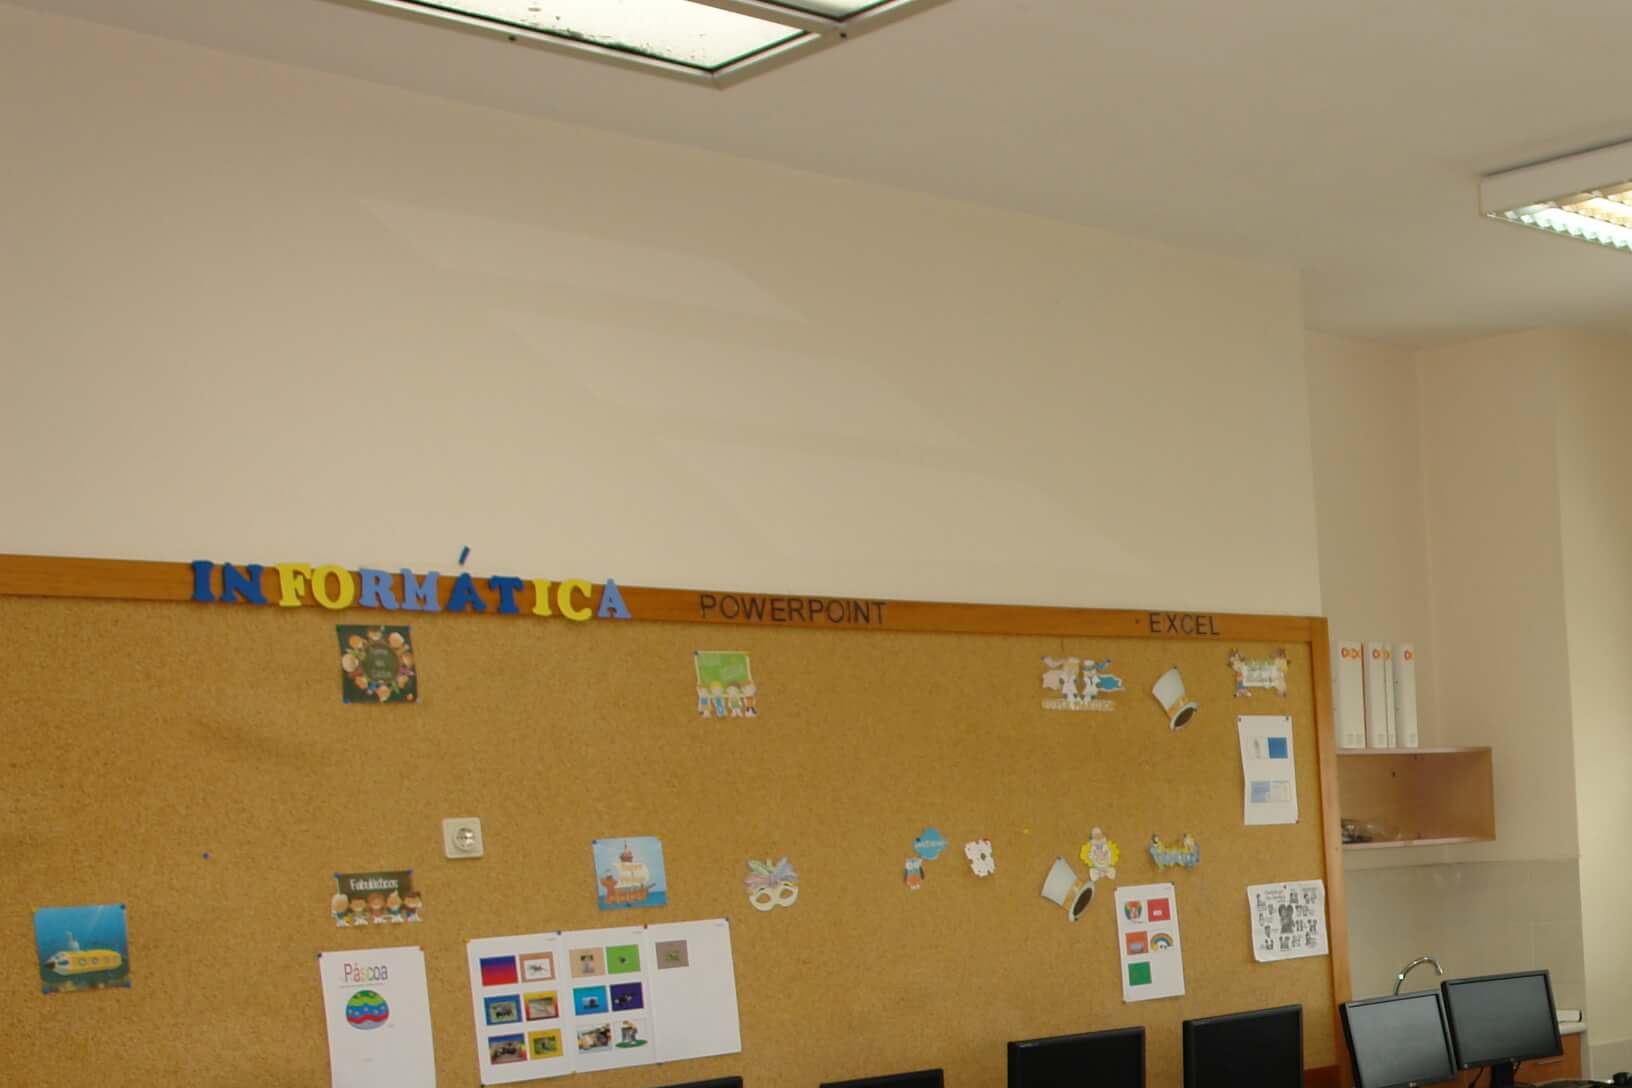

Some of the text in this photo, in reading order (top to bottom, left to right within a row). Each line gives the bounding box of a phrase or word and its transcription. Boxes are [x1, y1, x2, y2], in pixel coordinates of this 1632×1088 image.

[191, 546, 631, 620] INFORMÁTICA
[698, 594, 887, 625] POWERPOINT
[1149, 612, 1220, 636] EXCEL
[344, 963, 388, 982] Páscoa
